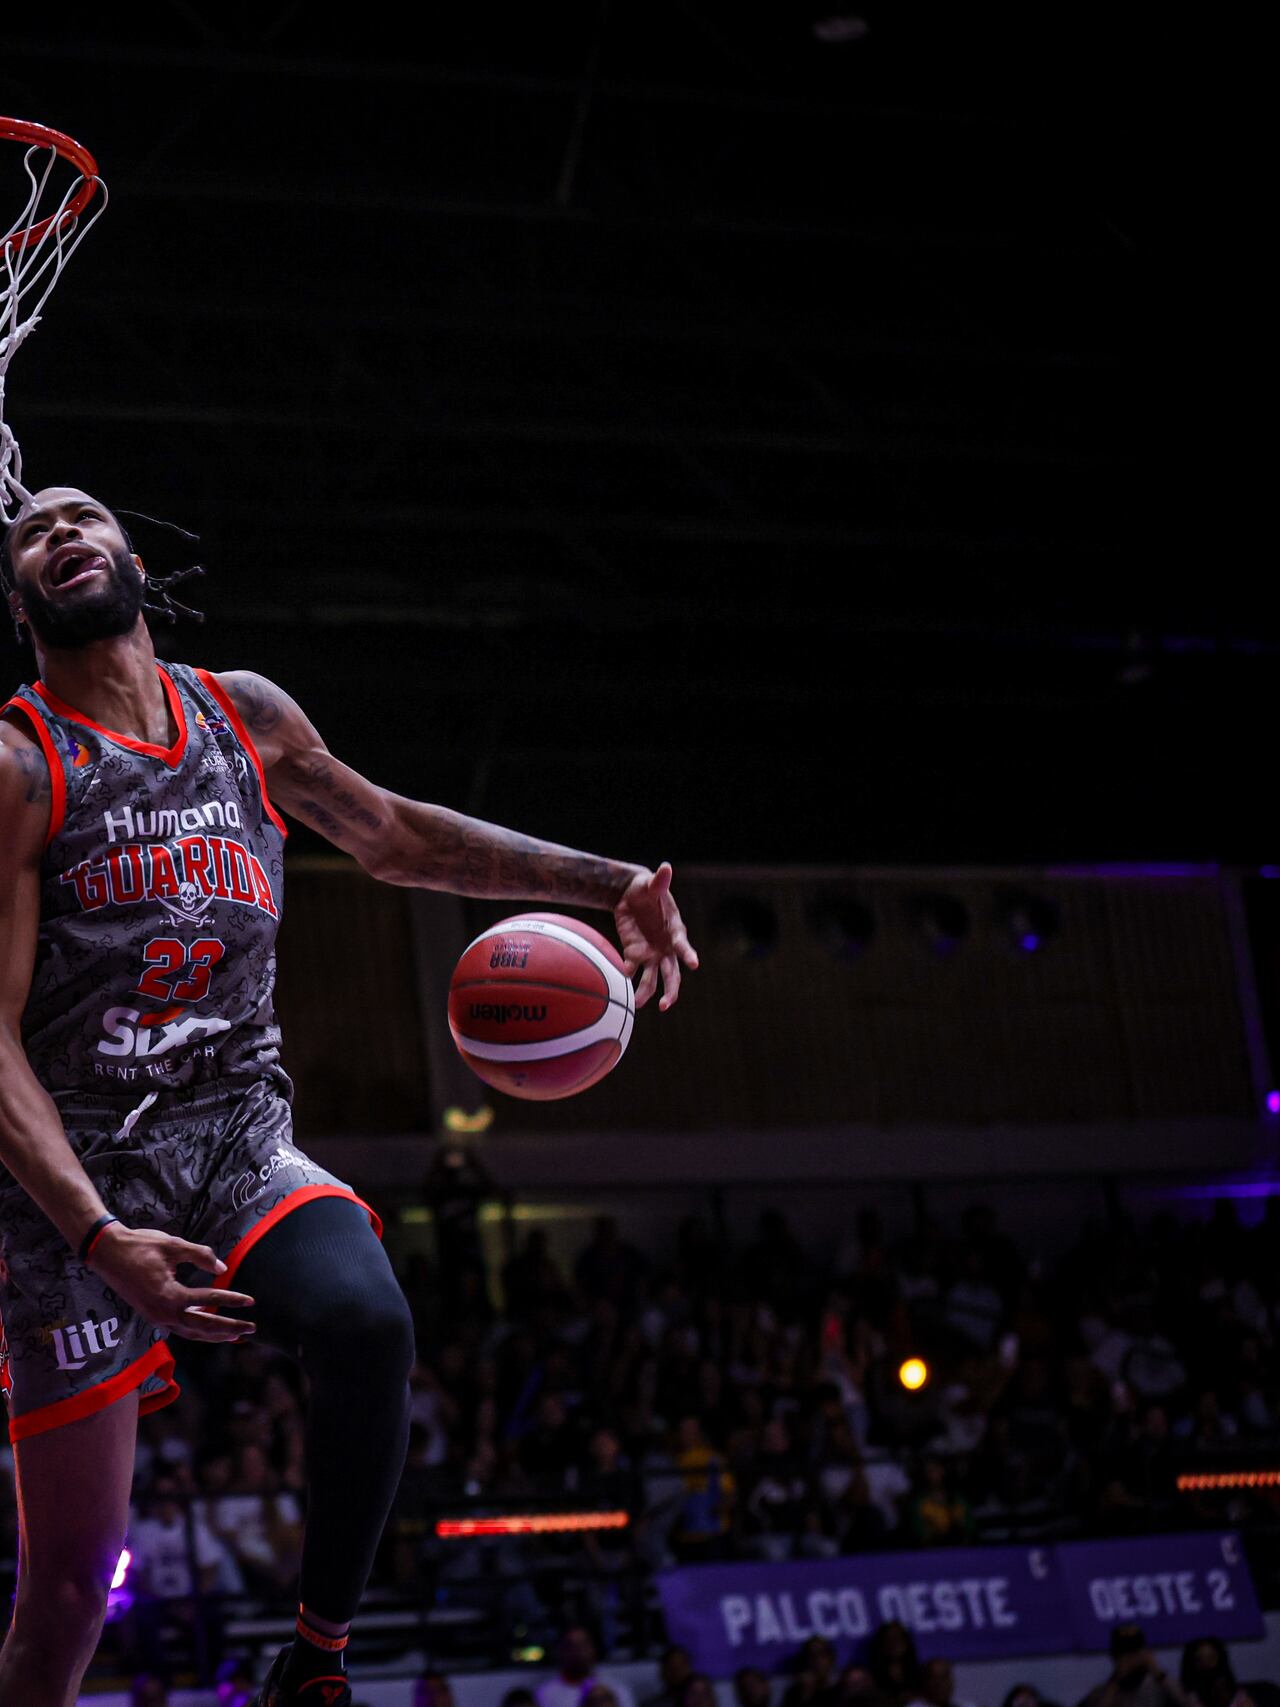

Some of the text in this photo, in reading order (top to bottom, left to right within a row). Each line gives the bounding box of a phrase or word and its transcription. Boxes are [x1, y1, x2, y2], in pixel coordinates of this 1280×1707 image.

[60, 834, 279, 921] GUARIDA
[128, 937, 225, 1002] 23
[469, 1003, 549, 1025] molten
[94, 1063, 138, 1081] RENT
[145, 1060, 172, 1078] THE
[48, 1316, 121, 1370] Lite
[721, 1576, 1018, 1647] PALCO OESTE
[1089, 1567, 1236, 1622] OESTE 2
